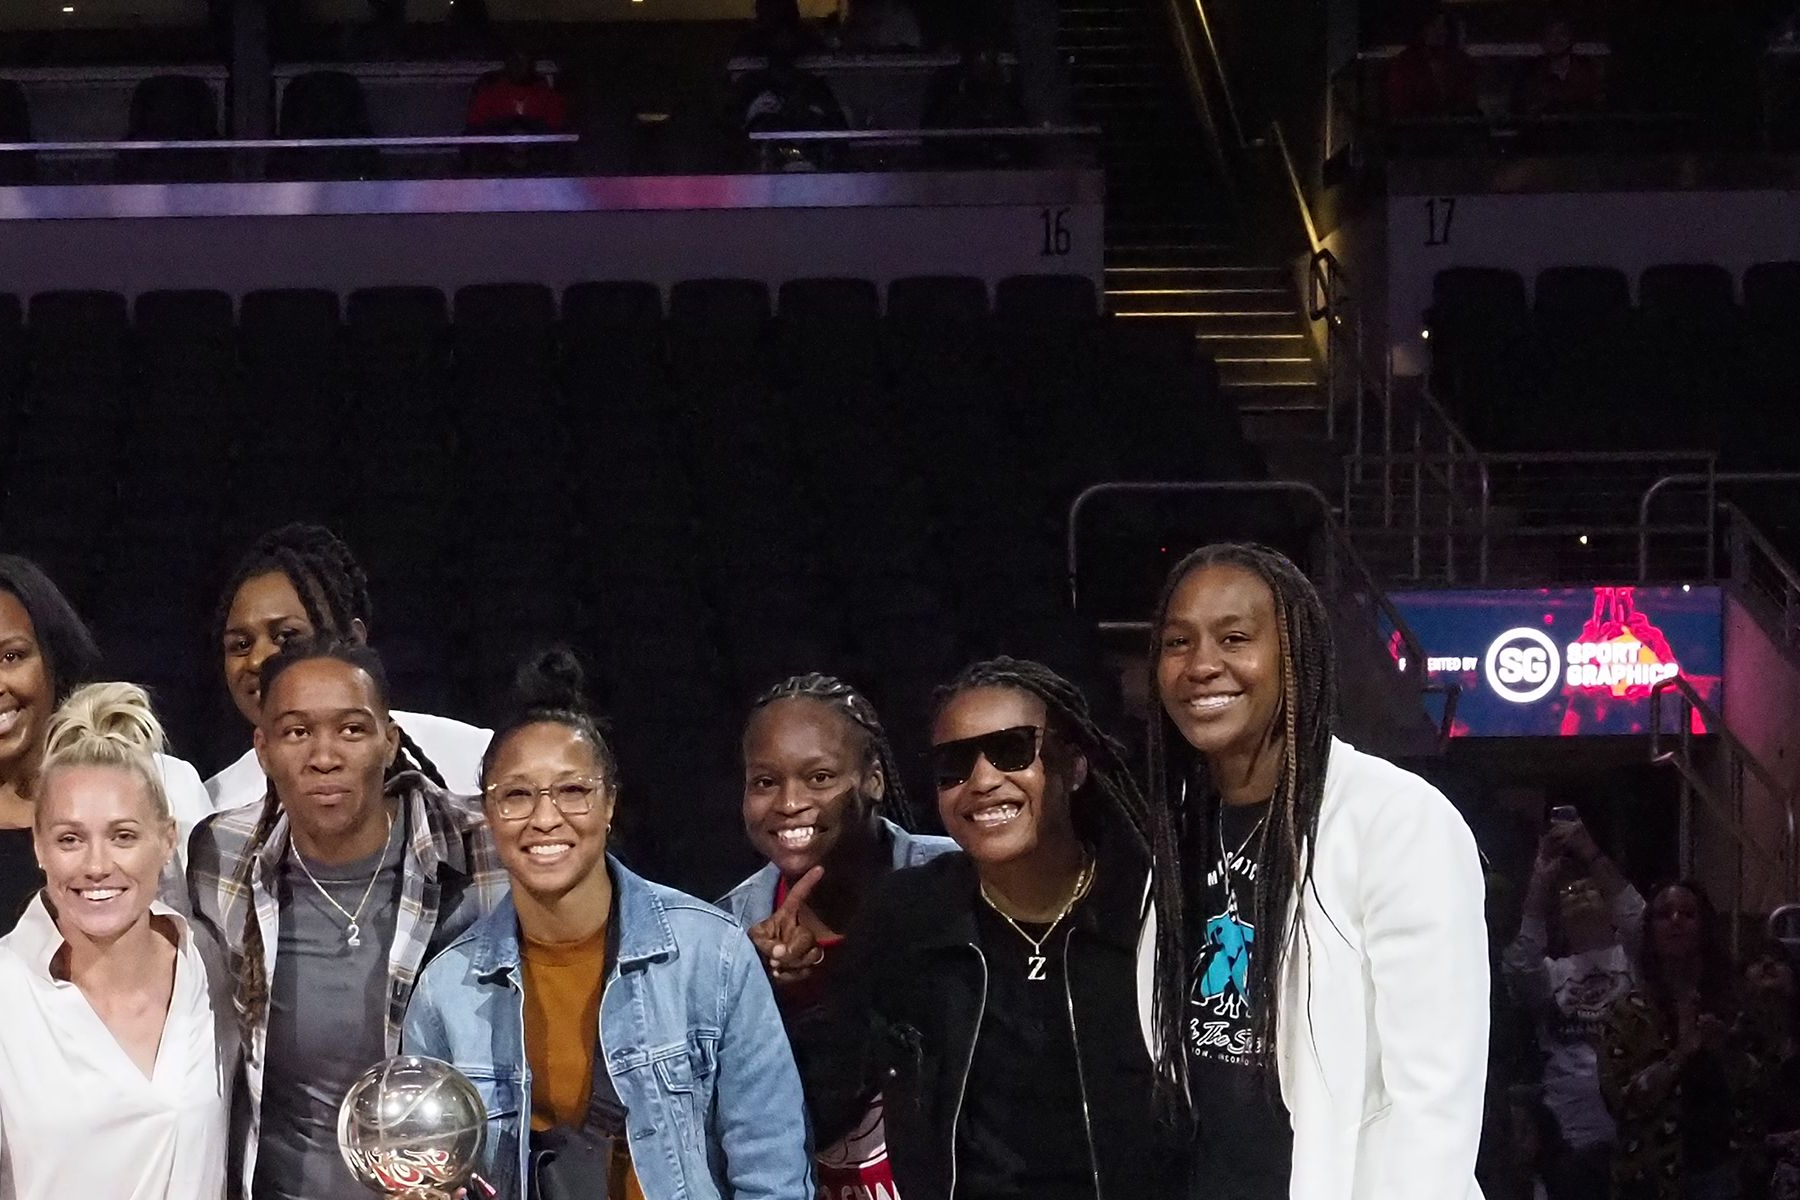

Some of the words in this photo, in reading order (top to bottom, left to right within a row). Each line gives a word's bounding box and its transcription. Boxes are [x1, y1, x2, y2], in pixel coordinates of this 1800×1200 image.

[1041, 208, 1071, 256] 16
[1424, 198, 1454, 247] 17
[1498, 647, 1547, 683] SG
[1566, 642, 1642, 664] SPORT
[348, 924, 360, 946] 2
[1028, 956, 1046, 981] Z
